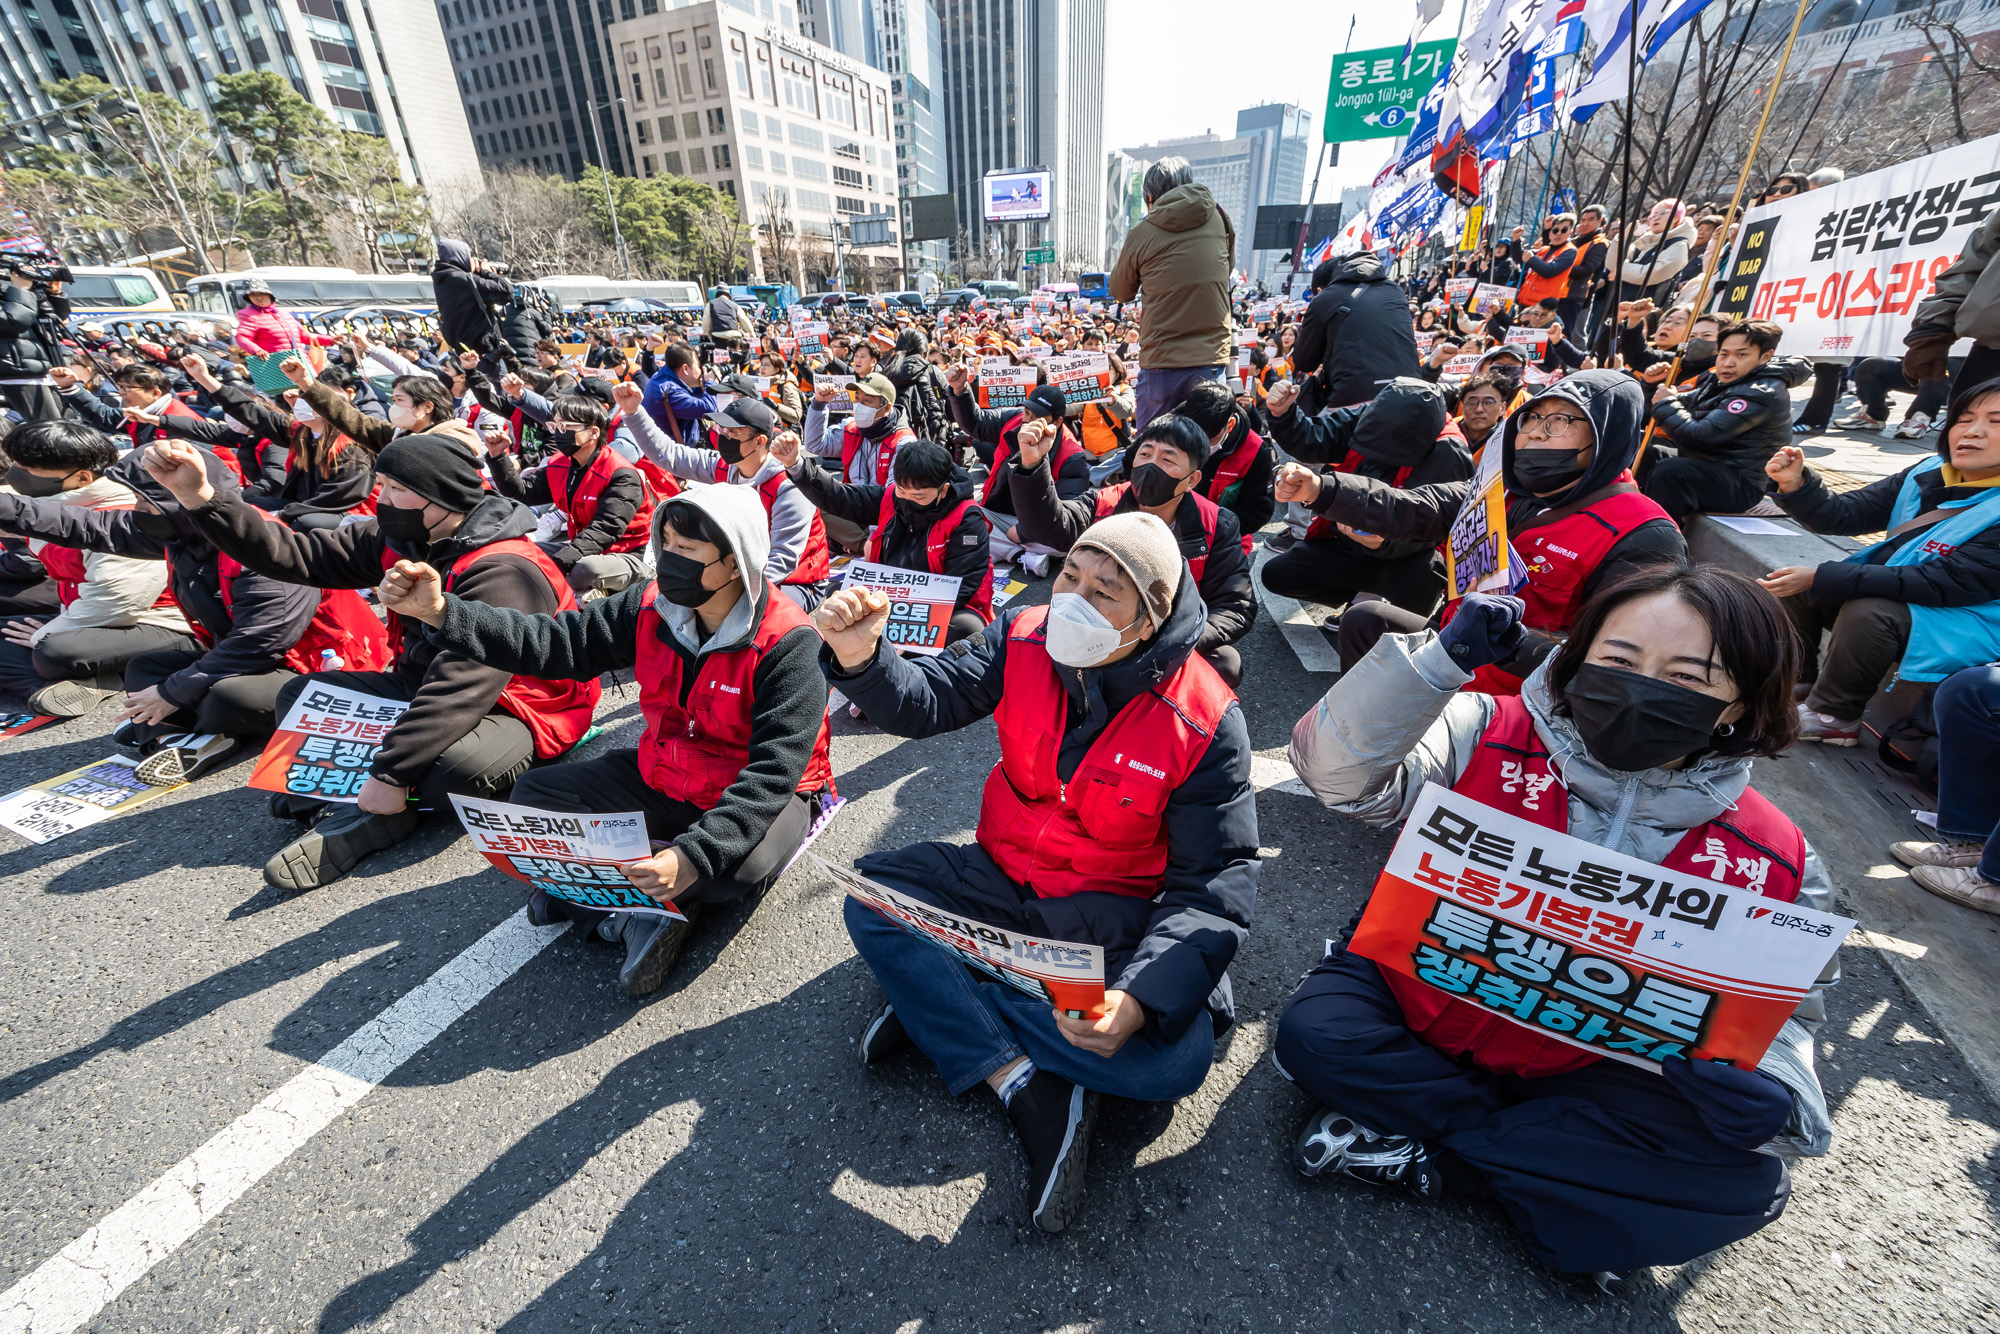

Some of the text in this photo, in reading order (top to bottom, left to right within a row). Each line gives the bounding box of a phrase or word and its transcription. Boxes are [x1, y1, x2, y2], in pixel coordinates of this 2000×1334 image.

[1340, 49, 1443, 88] 종로1가
[1335, 88, 1414, 109] Jongno 1(il)-ga
[1387, 109, 1398, 125] 6
[1747, 230, 1764, 250] NO
[1737, 258, 1761, 277] WAR
[1731, 285, 1749, 302] ON
[996, 368, 1020, 376] 노동자의
[1064, 359, 1090, 370] 노동자의
[987, 386, 1026, 396] 투쟁으로
[1059, 376, 1099, 392] 투쟁으로
[1451, 497, 1488, 560] 원청교섭
[849, 566, 876, 582] 모든
[880, 572, 930, 586] 노동자의
[889, 602, 931, 622] 으로
[883, 622, 939, 646] 하자!
[302, 690, 352, 716] 모든
[1500, 760, 1555, 811] 단결
[462, 806, 638, 838] 모든 노동자의 민주노총
[480, 834, 575, 858] 노동기본권
[507, 855, 634, 886] 투쟁으로
[1418, 805, 1835, 938] 모든 노동자의 민주노총
[1691, 837, 1772, 896] 투쟁
[1412, 852, 1645, 956] 노동기본권
[886, 893, 1013, 949] 노동자의
[1042, 942, 1092, 956] 민주노총
[1427, 904, 1712, 1043] 투쟁으로
[1415, 945, 1735, 1066] 쟁취하자
